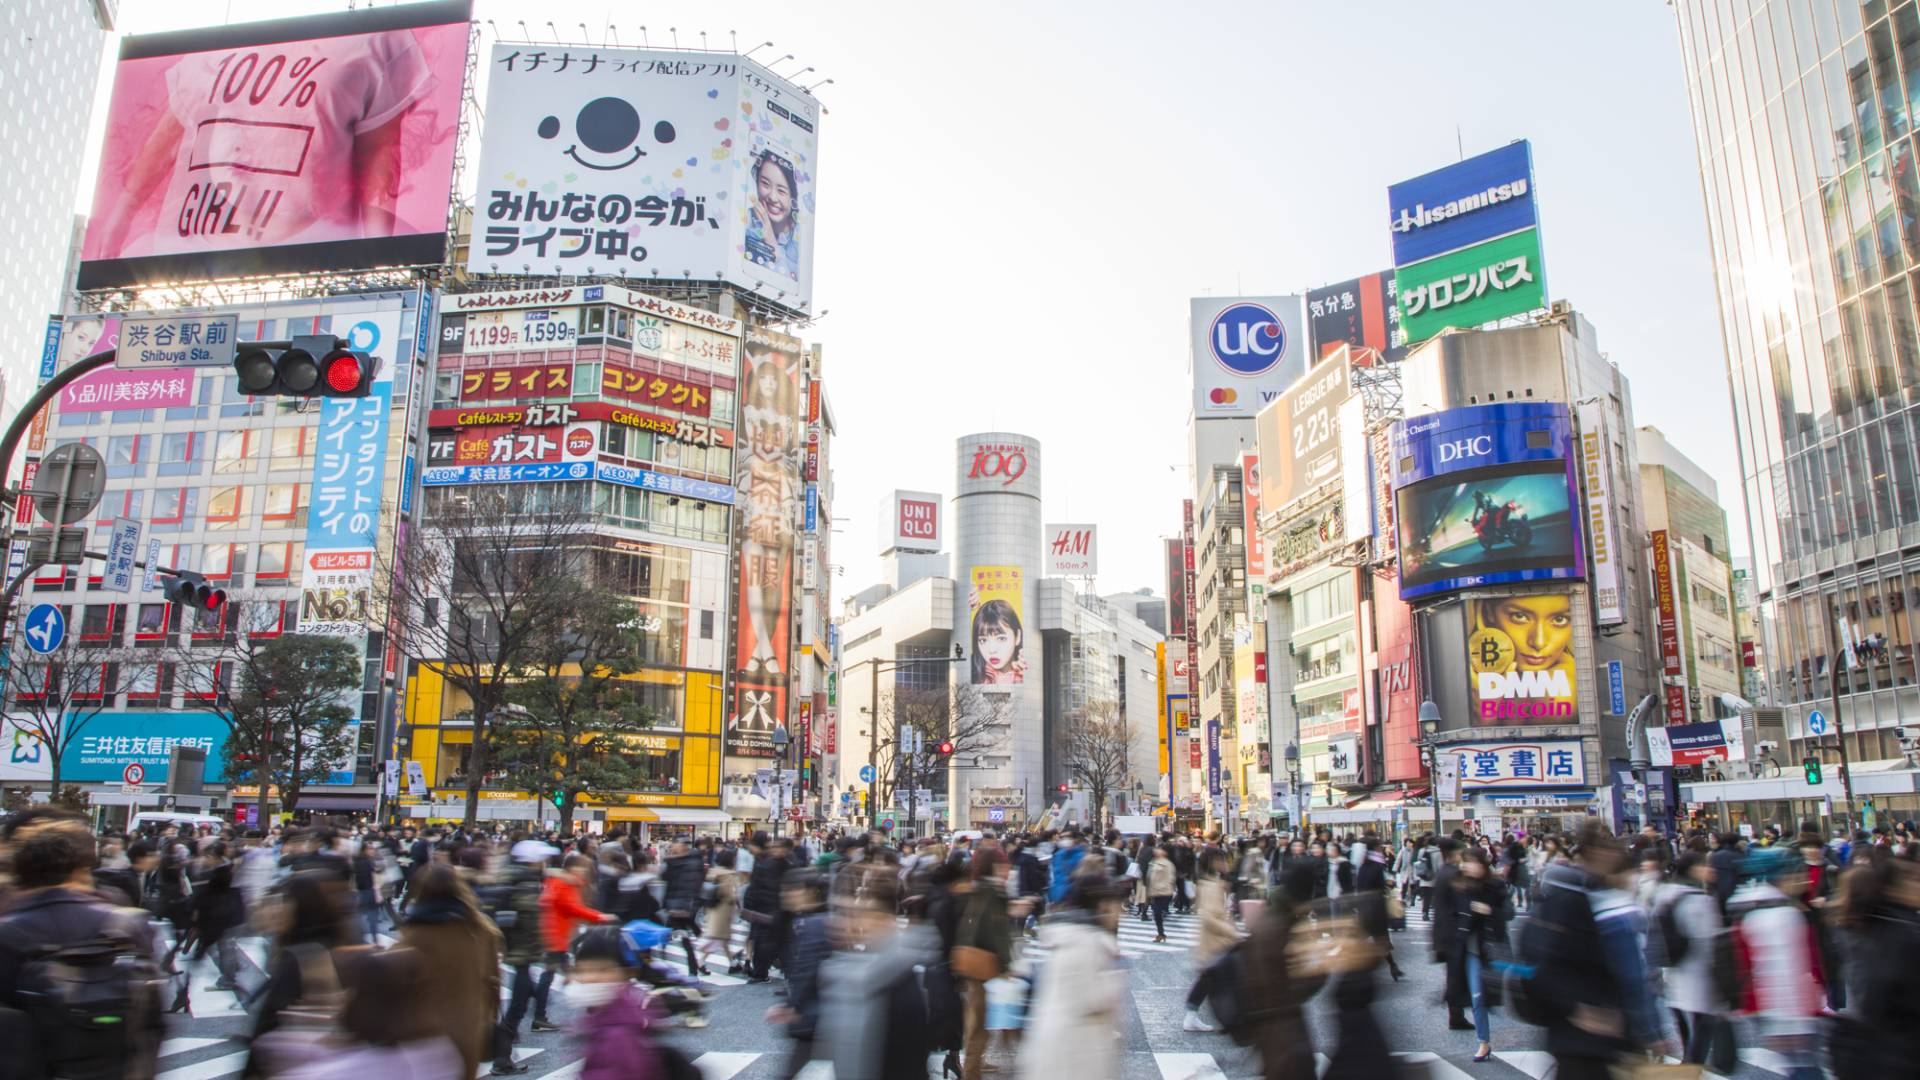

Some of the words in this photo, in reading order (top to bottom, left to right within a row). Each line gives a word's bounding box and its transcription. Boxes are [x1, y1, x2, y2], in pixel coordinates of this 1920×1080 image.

[498, 51, 606, 74] イチナナ
[612, 58, 736, 77] ライブ配信アプリ
[208, 52, 328, 108] 100%
[745, 73, 781, 98] イチナナ
[177, 181, 284, 241] GIRL!!
[487, 190, 720, 229] みんなの今が、
[1390, 178, 1528, 233] Hisamitsu
[485, 226, 648, 261] ライブ中。
[1403, 255, 1534, 316] サロンパス
[458, 289, 573, 309] しゃぶしゃぶバイキング
[628, 292, 737, 331] しゃぶしゃぶバイキング
[1310, 291, 1356, 318] 気分急
[127, 320, 228, 348] 渋谷駅前
[443, 324, 464, 341] 9F
[524, 321, 576, 345] 1,599円
[141, 349, 186, 364] Shibuya
[190, 348, 214, 361] Sta.
[79, 379, 187, 404] 品川美容外科
[464, 367, 569, 395] プライス
[603, 366, 708, 408] コンタクト
[525, 404, 578, 426] ガスト
[1410, 418, 1441, 436] Channel
[460, 440, 489, 452] Café
[569, 440, 593, 449] ガスト
[676, 420, 724, 447] ガスト
[1293, 406, 1330, 460] 2.23
[431, 441, 456, 458] 7F
[490, 434, 557, 463] ガスト
[978, 444, 1025, 453] SHIBUYA
[1439, 435, 1493, 463] DHC
[319, 397, 356, 536] アイシティ
[349, 395, 382, 534] コンタクトの
[428, 469, 460, 482] AEON
[468, 466, 566, 482] 英会話イーオン
[967, 450, 1028, 486] 109
[603, 465, 636, 483] AEON
[642, 472, 733, 500] 英会話イーオン
[904, 505, 931, 519] UNI
[904, 521, 933, 535] QLO
[1591, 503, 1609, 565] neon
[1051, 530, 1091, 556] H&M
[1055, 562, 1080, 570] 150m
[1467, 576, 1484, 585] DHC
[300, 586, 370, 622] No.1
[1478, 670, 1572, 700] DMM
[1480, 697, 1572, 719] Bitcoin
[750, 740, 775, 748] DOMINA
[80, 756, 115, 765] SUMITOMO
